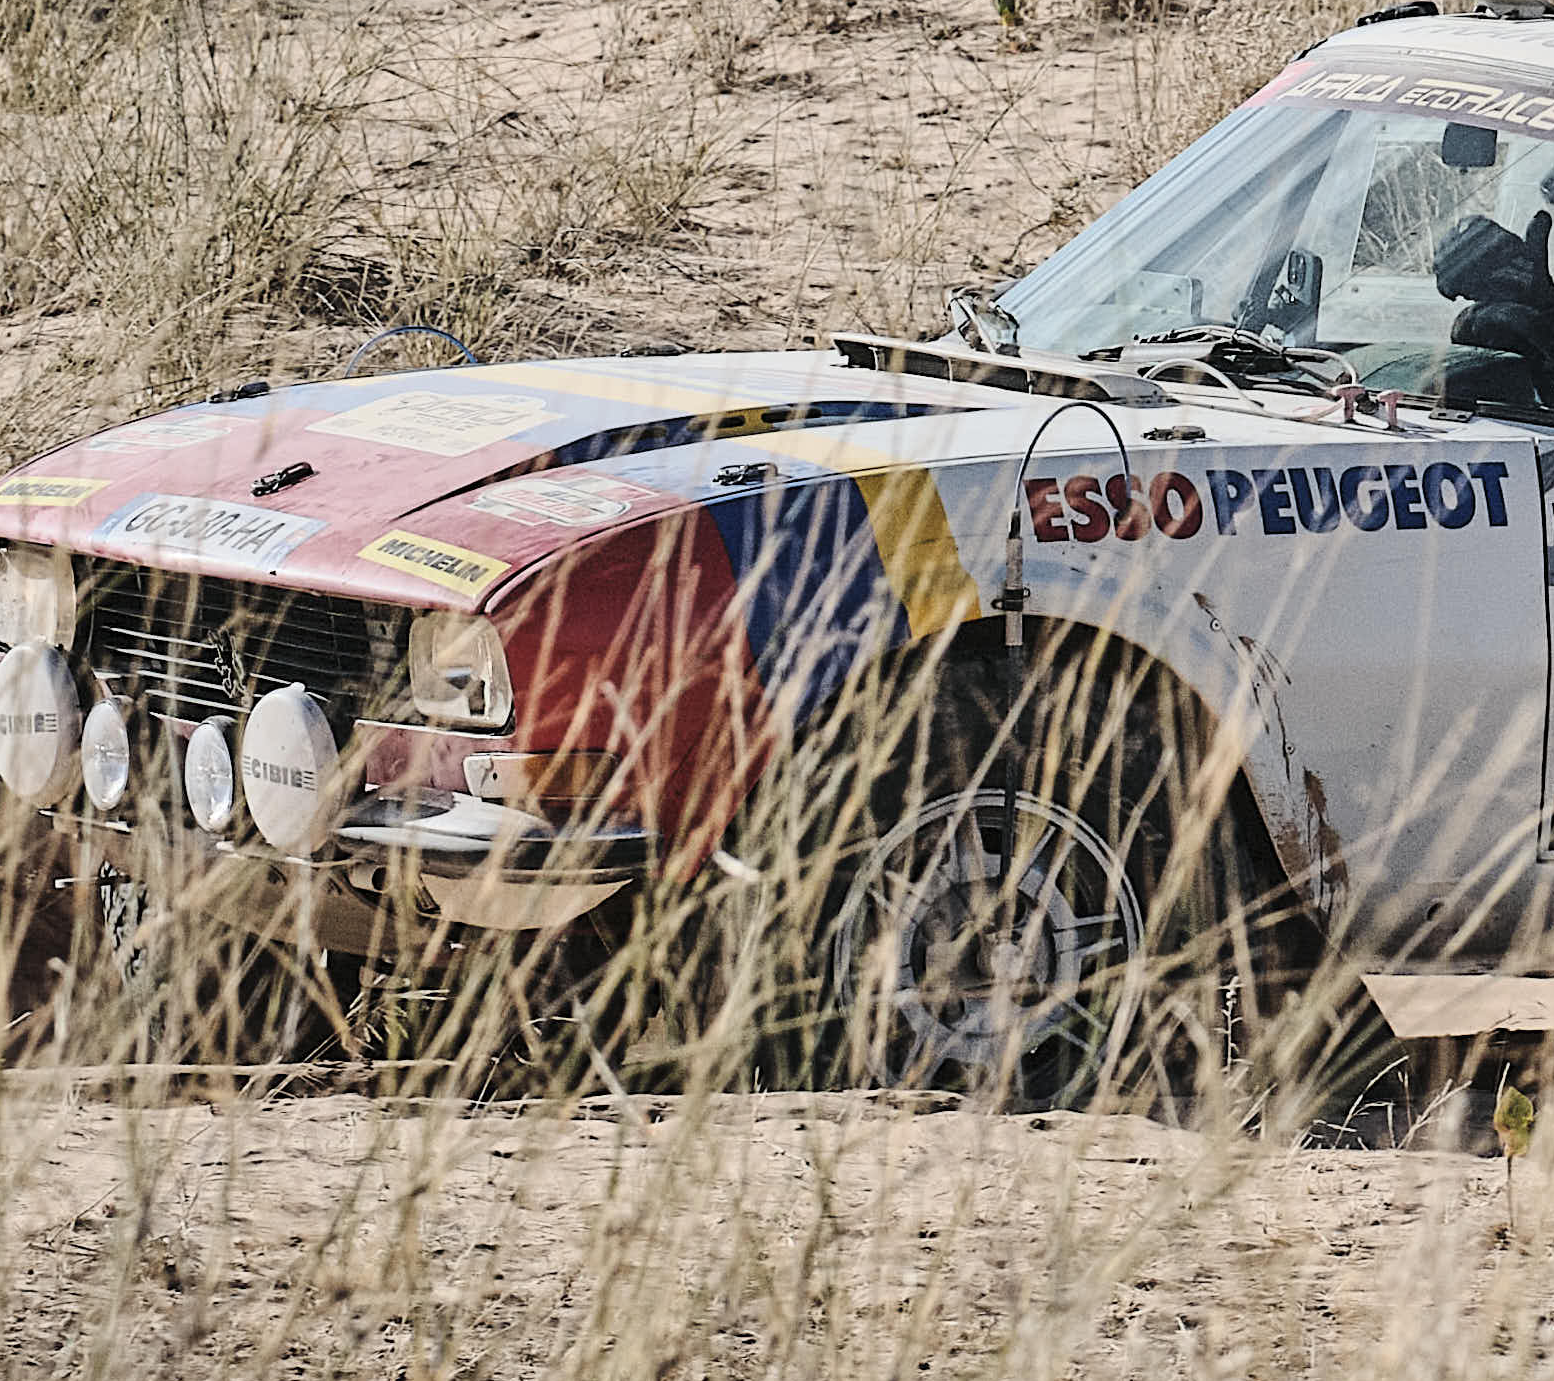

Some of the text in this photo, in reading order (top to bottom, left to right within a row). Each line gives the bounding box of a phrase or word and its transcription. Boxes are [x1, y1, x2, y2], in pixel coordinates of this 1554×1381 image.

[1277, 71, 1406, 103] AFRICA
[1023, 461, 1509, 544] ESSO PEUGEOT
[377, 538, 492, 583] MICHELIN
